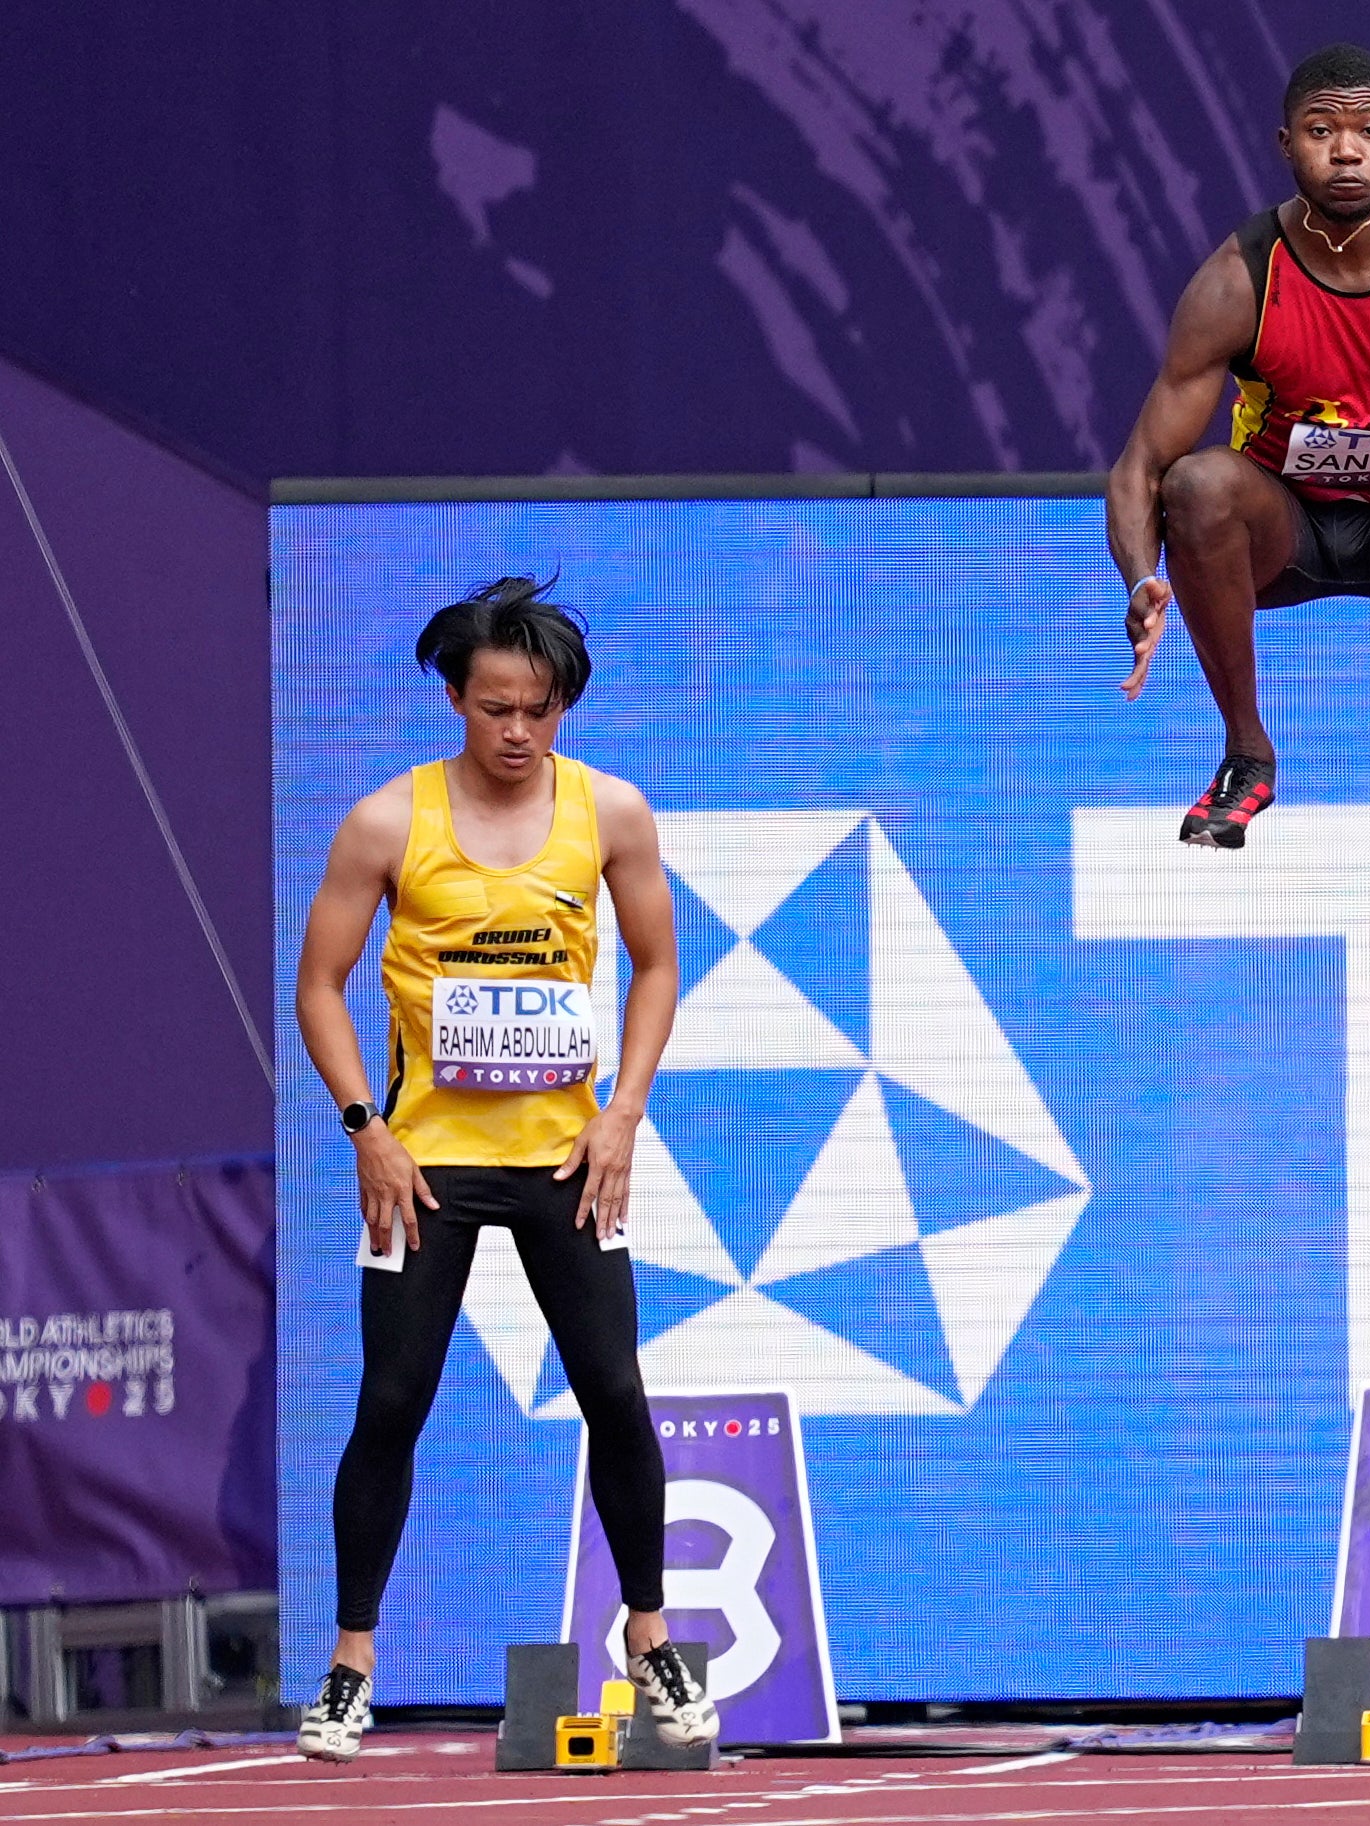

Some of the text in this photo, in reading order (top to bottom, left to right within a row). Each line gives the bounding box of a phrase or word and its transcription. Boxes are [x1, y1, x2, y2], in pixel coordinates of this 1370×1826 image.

[472, 928, 552, 945] BRUNEI
[479, 986, 580, 1017] TDK
[439, 1025, 591, 1058] RAHIM ABDULLAH
[40, 1308, 174, 1345] ATHLETICS
[659, 1417, 781, 1438] OKYO25
[605, 1479, 782, 1700] 8
